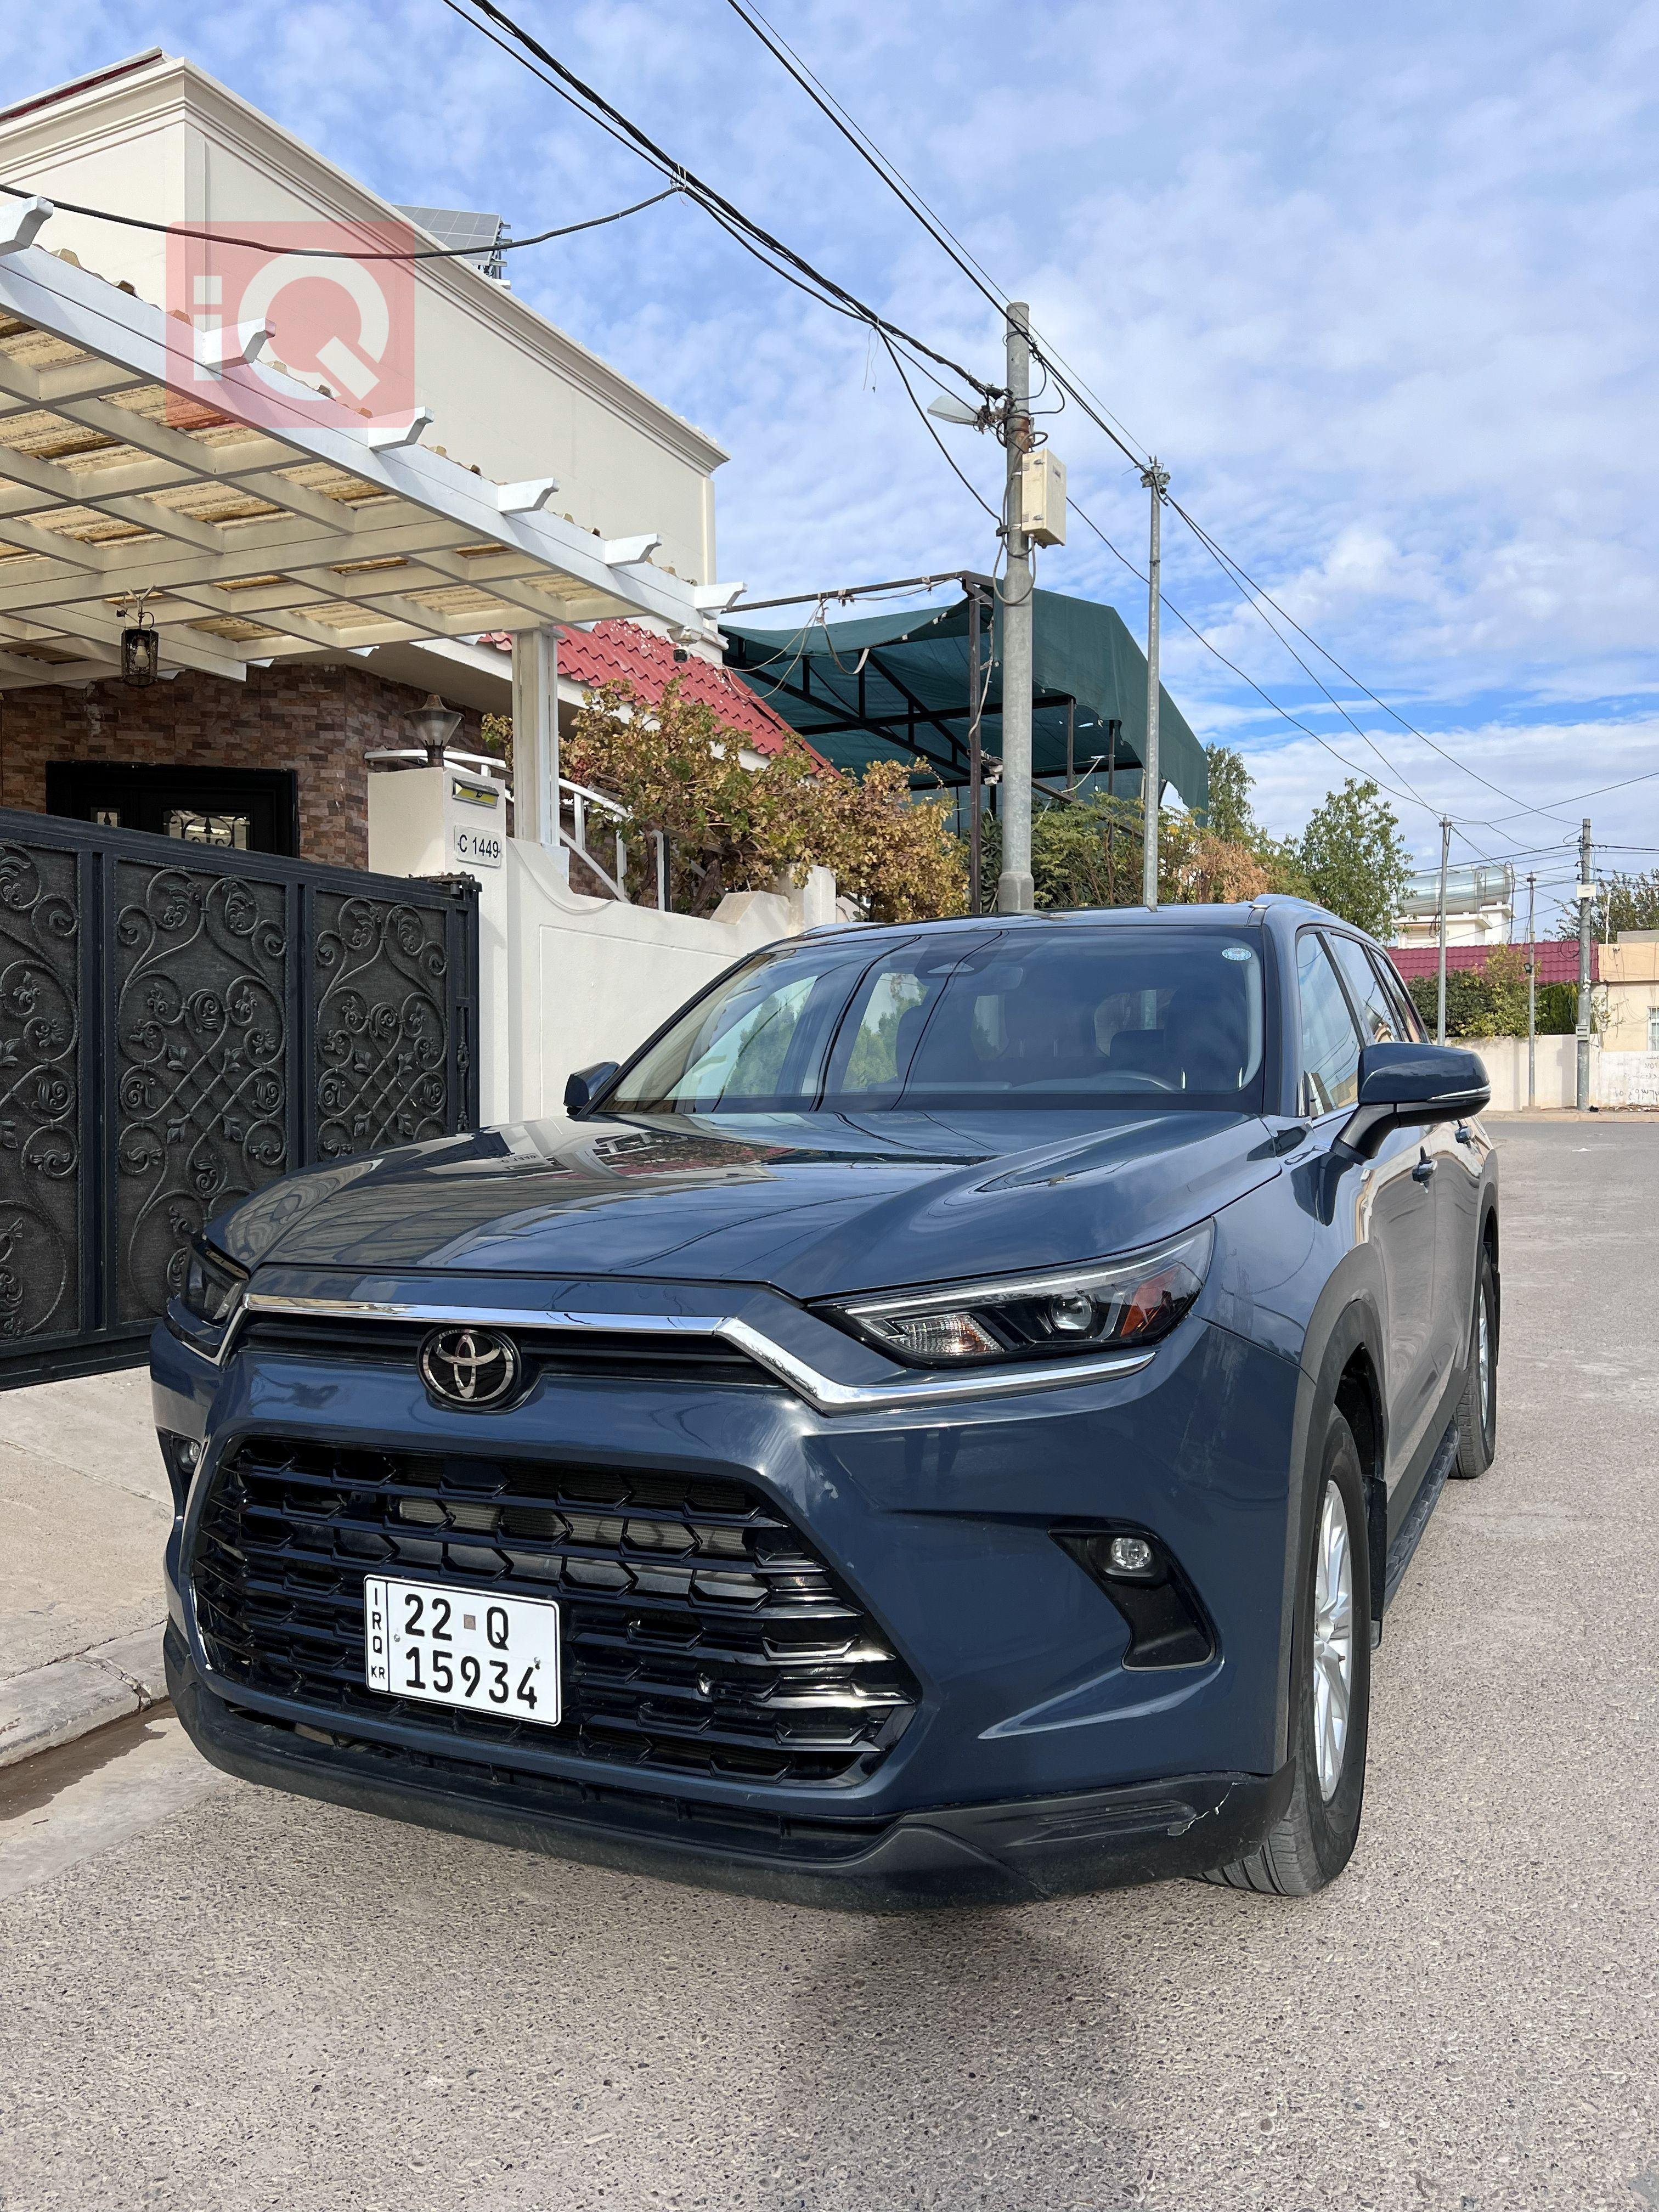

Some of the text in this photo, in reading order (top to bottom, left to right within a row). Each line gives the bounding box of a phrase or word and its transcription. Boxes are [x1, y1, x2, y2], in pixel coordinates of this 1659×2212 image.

[459, 834, 499, 859] C 1449
[371, 1587, 382, 1655] IRQ
[404, 1593, 509, 1651] 22 Q
[370, 1664, 386, 1680] KR
[405, 1646, 538, 1709] 15934
